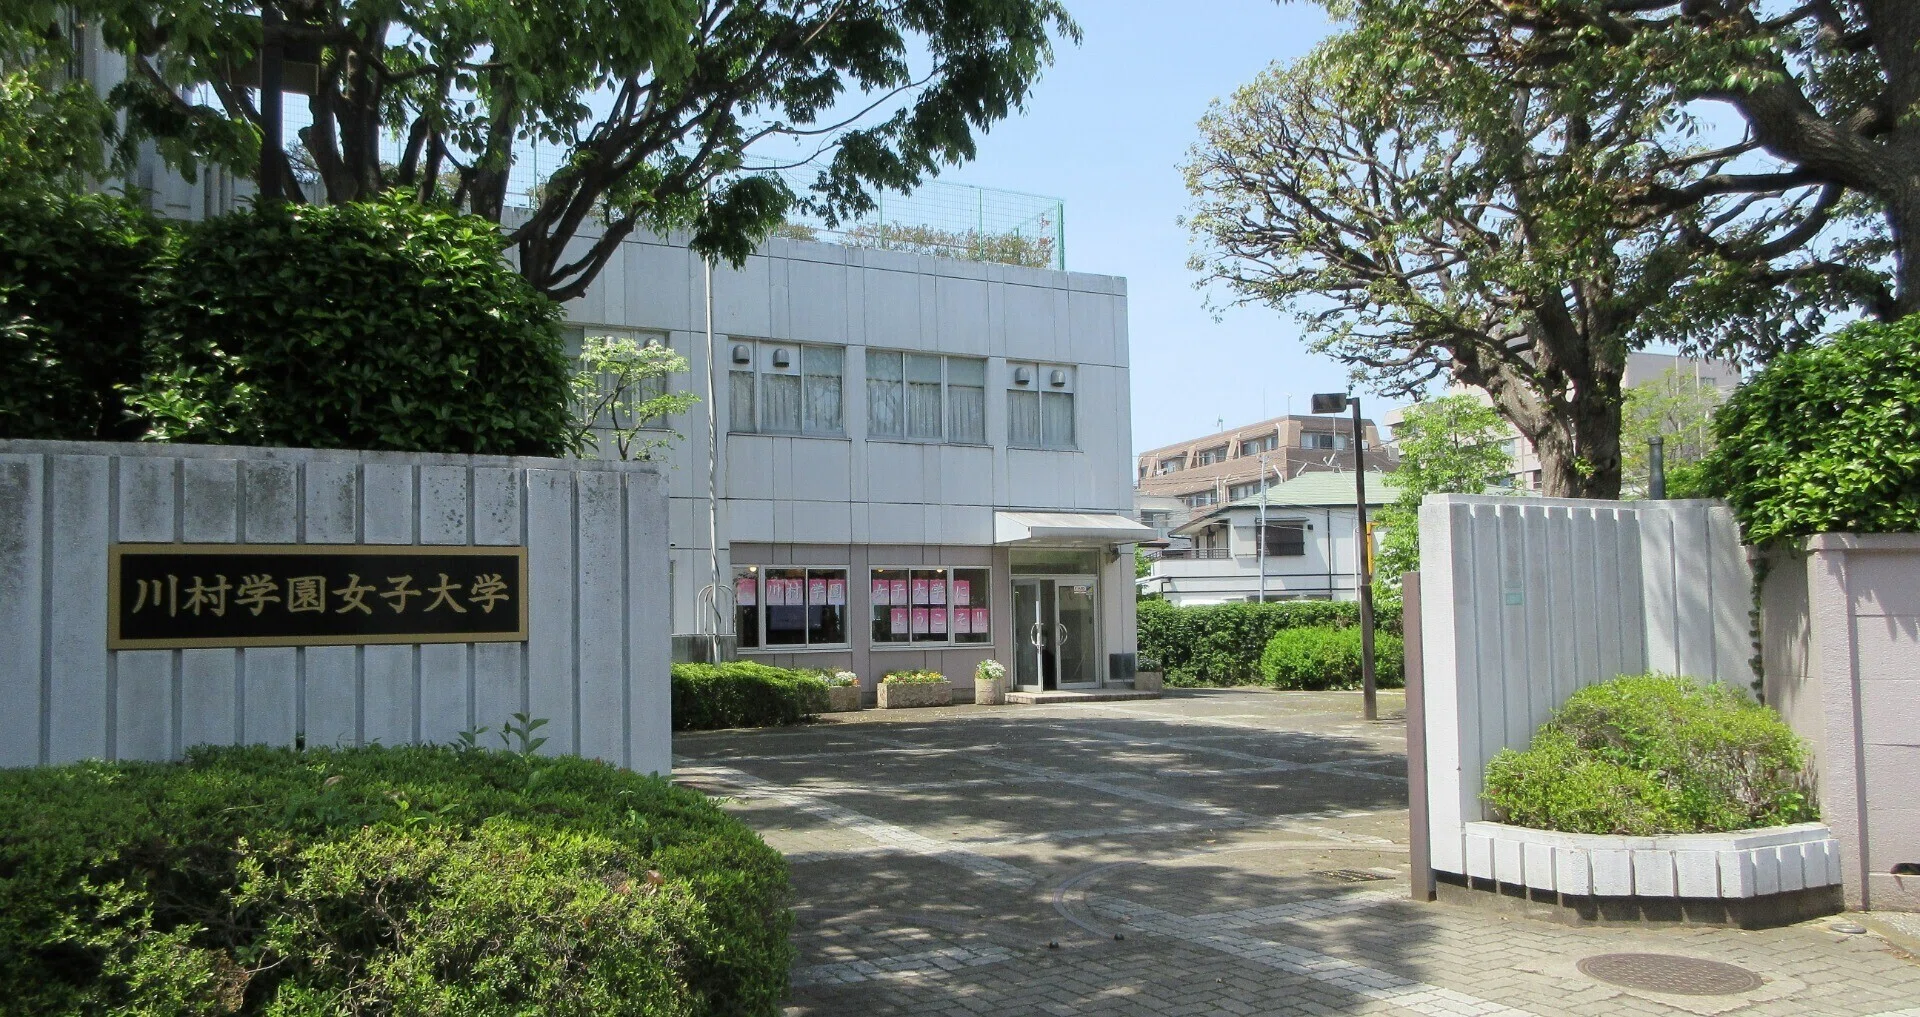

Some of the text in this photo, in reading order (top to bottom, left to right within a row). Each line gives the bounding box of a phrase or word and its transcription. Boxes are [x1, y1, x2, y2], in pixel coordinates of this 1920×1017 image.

[132, 572, 510, 617] 川村学園女子大学
